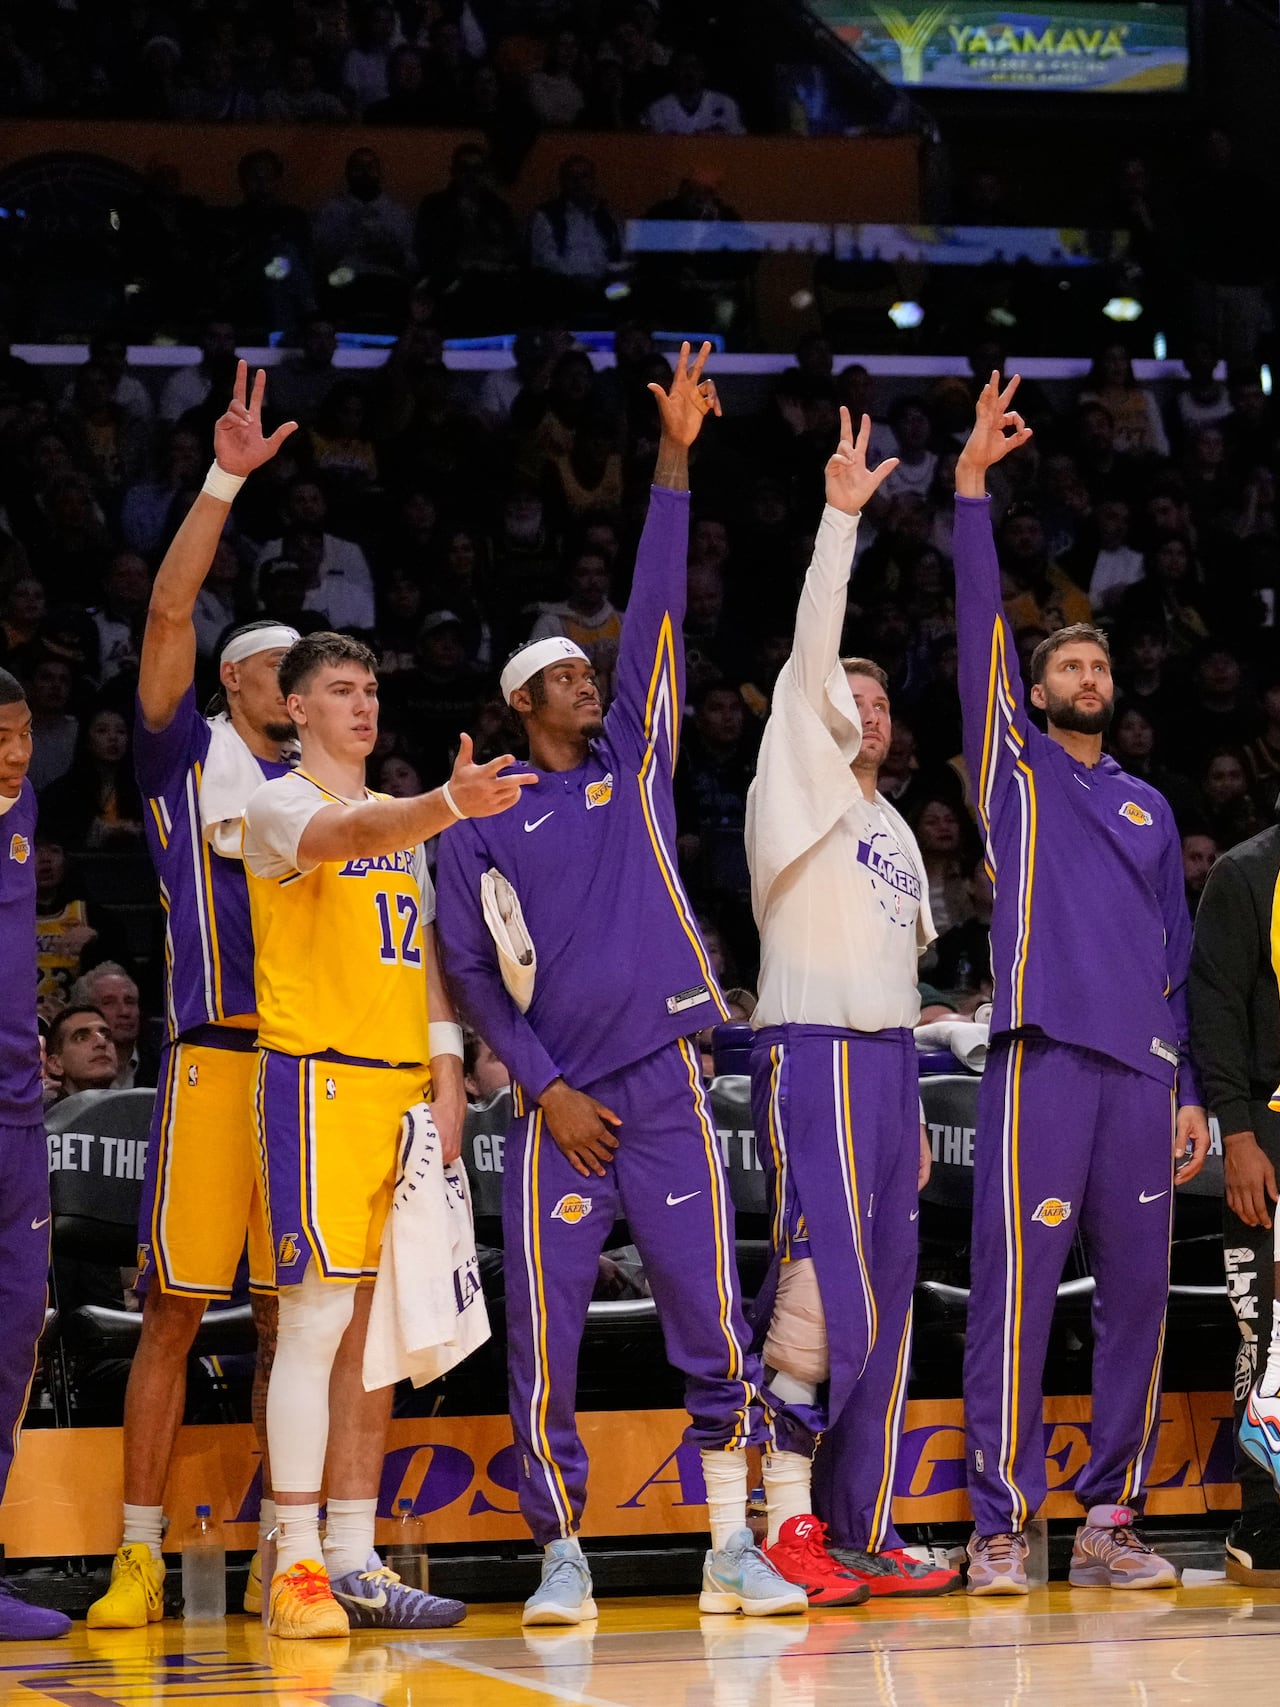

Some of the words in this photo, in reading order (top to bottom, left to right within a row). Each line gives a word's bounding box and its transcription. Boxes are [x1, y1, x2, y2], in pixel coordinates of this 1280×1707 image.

[338, 850, 414, 877] LAKER
[867, 845, 920, 896] LAKERS
[375, 891, 422, 969] 12
[46, 1132, 95, 1173] GET
[100, 1136, 149, 1180] THE
[472, 1134, 505, 1173] GE
[929, 1123, 976, 1167] THE
